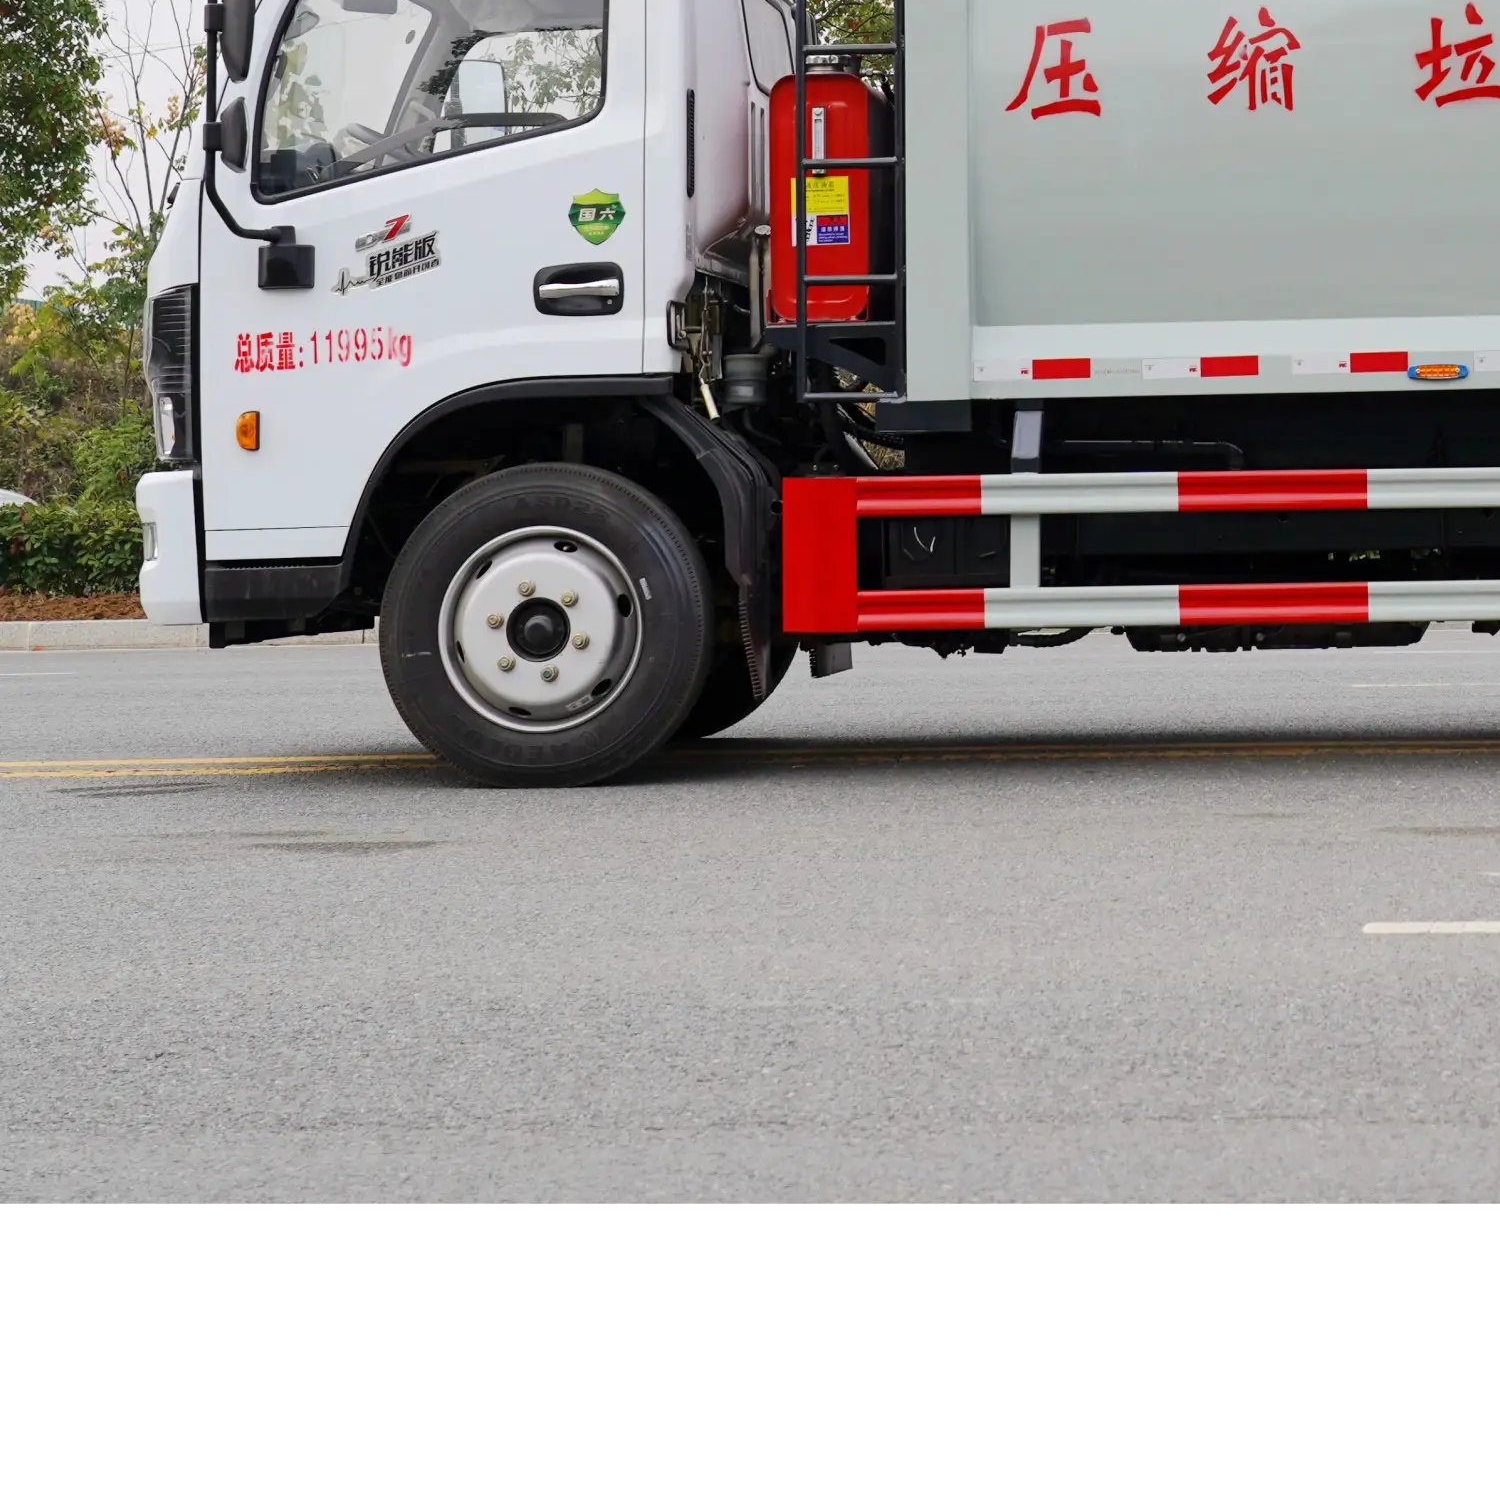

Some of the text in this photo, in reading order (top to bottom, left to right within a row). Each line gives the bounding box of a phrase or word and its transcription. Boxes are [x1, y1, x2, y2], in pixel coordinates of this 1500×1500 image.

[577, 207, 616, 222] 国六
[369, 230, 437, 280] 锐能版
